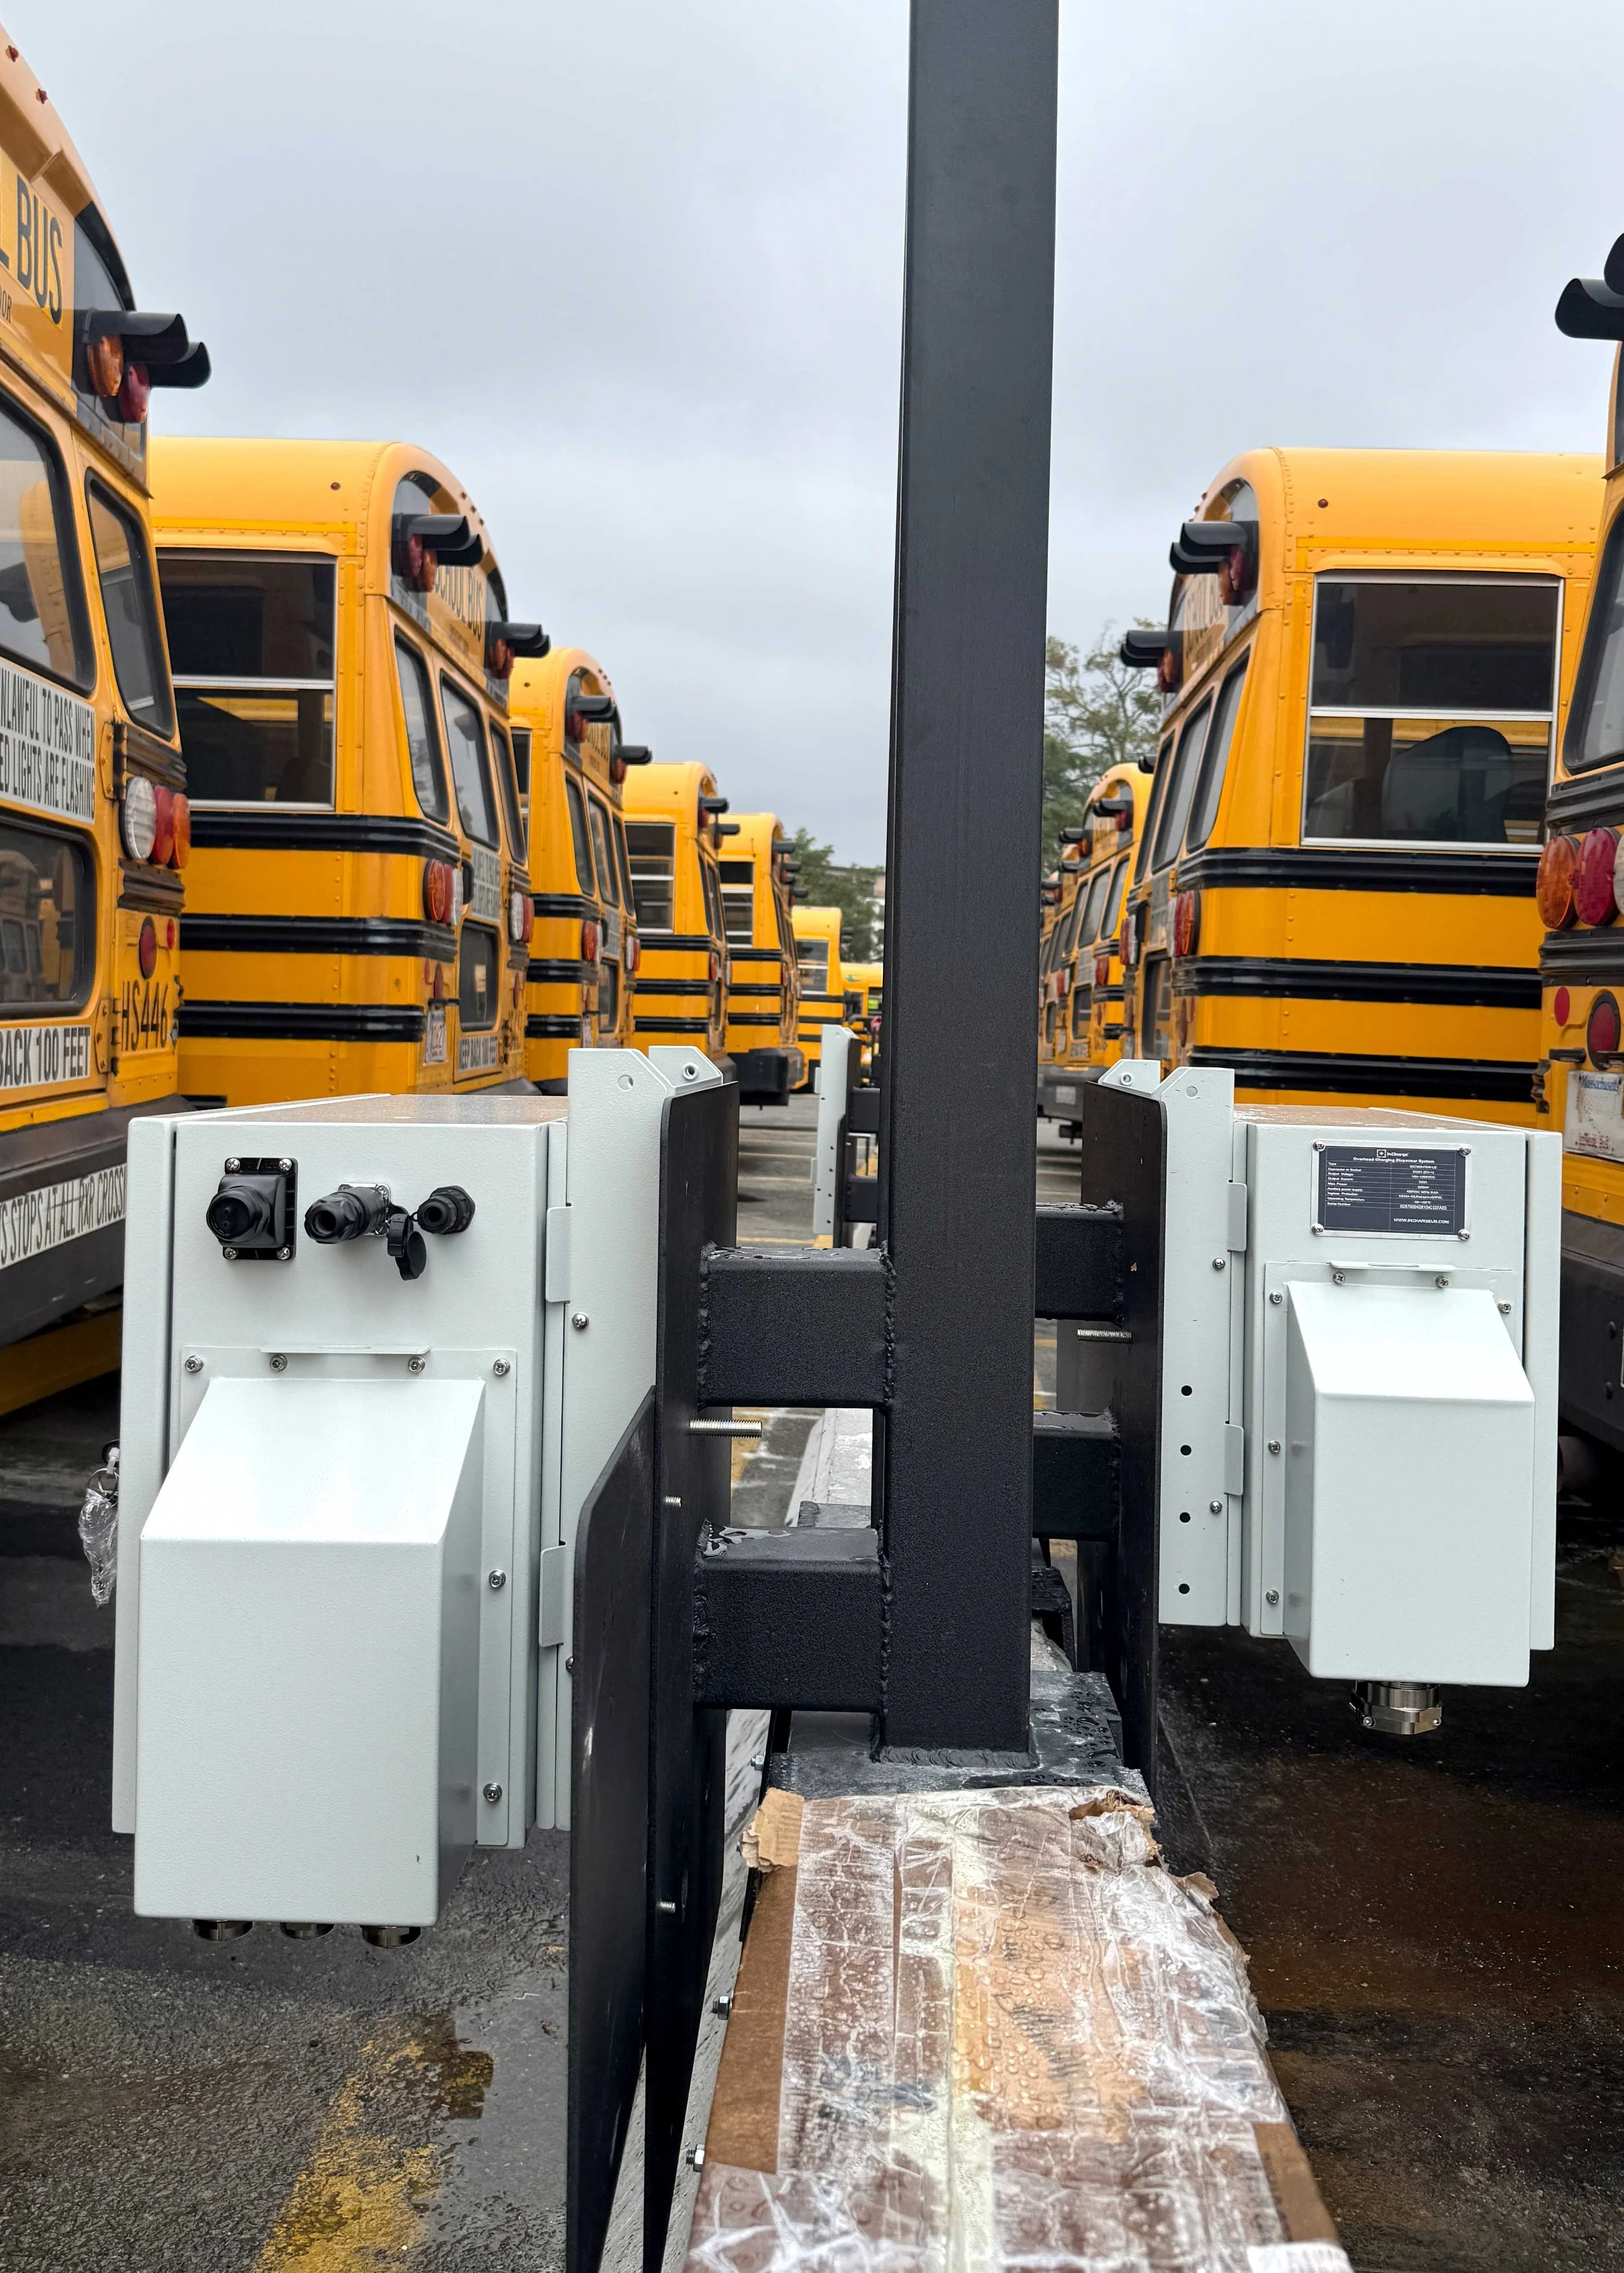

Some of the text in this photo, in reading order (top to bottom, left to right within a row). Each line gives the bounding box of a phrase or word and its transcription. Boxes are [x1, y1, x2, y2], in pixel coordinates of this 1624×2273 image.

[18, 173, 62, 324] BUS
[42, 688, 52, 746] TO
[55, 693, 73, 754] PASS
[13, 738, 42, 804] LIGHTS
[45, 750, 59, 807] ARE
[121, 980, 168, 1052] HS446
[36, 1028, 59, 1082] 100
[63, 1026, 90, 1078] FEET
[10, 1191, 43, 1261] STOPS
[45, 1186, 58, 1248] AT
[59, 1181, 75, 1241] ALL
